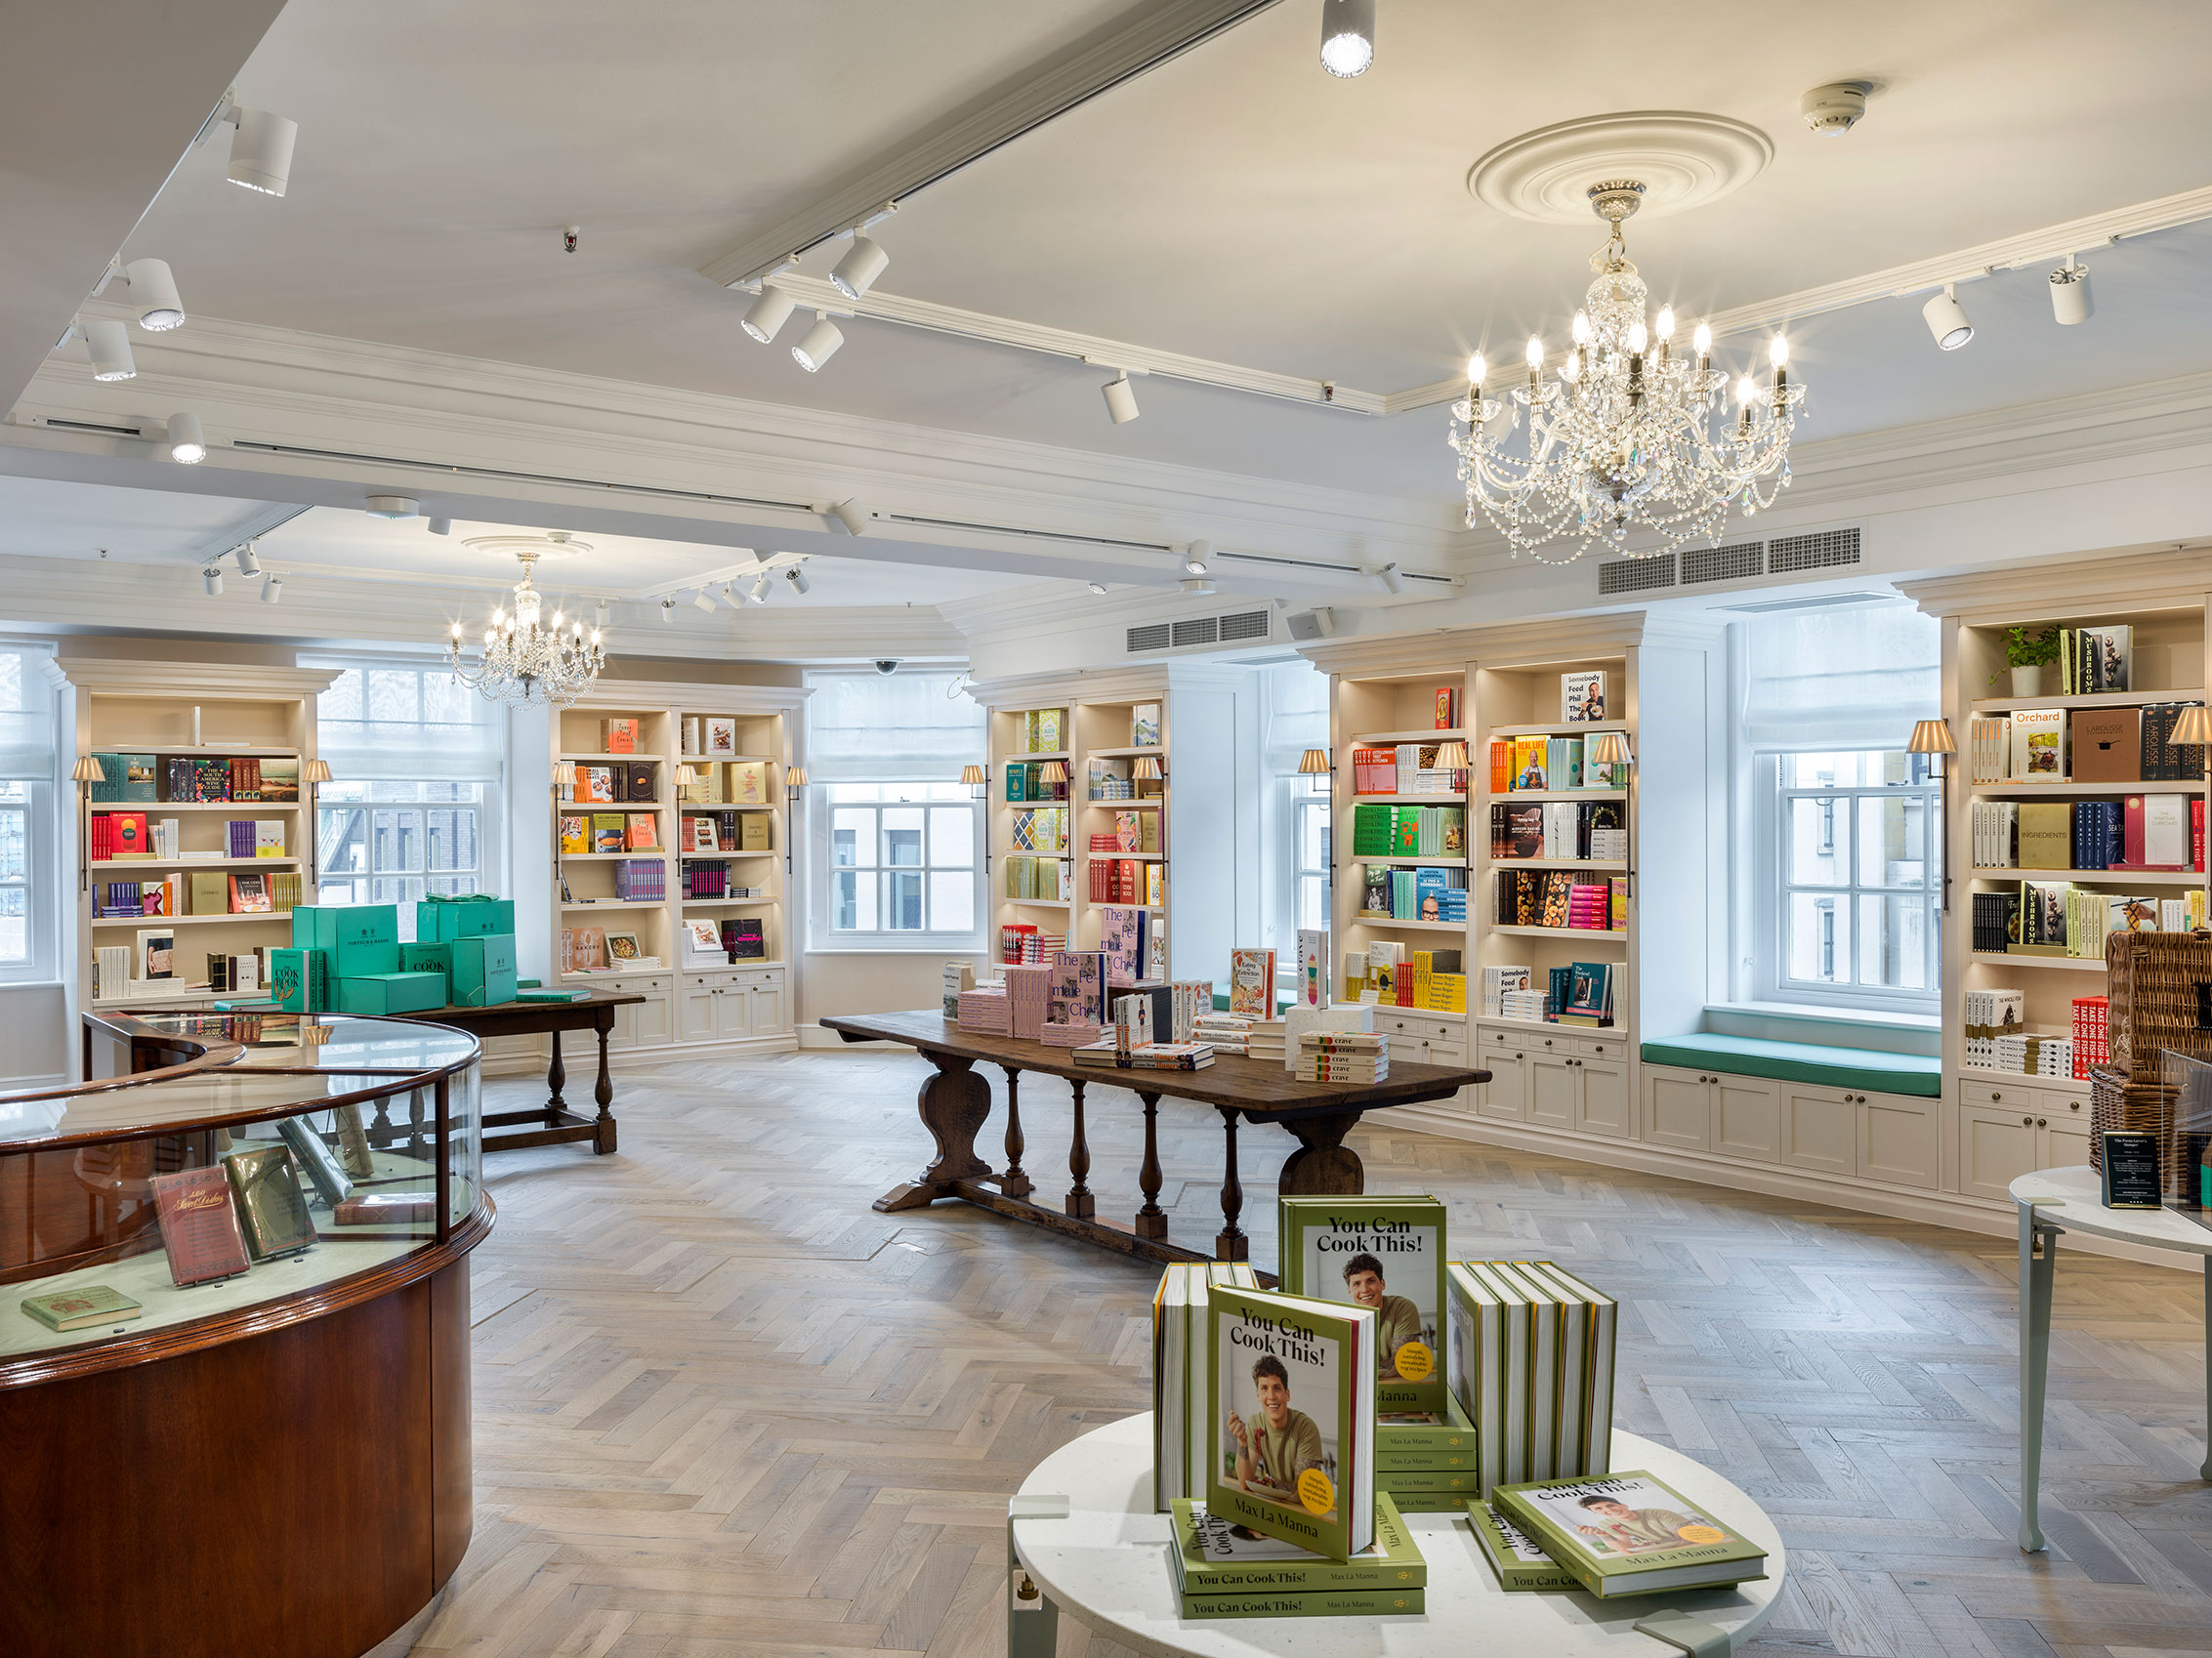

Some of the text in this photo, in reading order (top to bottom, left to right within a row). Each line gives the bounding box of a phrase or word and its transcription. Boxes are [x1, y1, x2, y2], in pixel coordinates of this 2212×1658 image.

[1568, 675, 1600, 683] Somebody
[2016, 712, 2059, 722] Orchard
[1518, 741, 1545, 749] REAL LIFE
[2150, 720, 2159, 766] LAROUSSE
[1104, 907, 1122, 921] The
[1122, 925, 1137, 938] Fe-
[1101, 937, 1123, 951] male
[1055, 953, 1078, 966] The
[1113, 957, 1136, 969] Chef
[414, 961, 444, 972] COOK
[275, 969, 298, 978] COOK
[1079, 970, 1100, 983] Fe-
[276, 977, 298, 987] BOOK
[1052, 984, 1081, 996] male
[1070, 1002, 1099, 1016] Chef
[1132, 1040, 1153, 1051] Hungry
[1329, 1217, 1411, 1233] You Can
[1317, 1235, 1422, 1252] Cook This!
[1241, 1307, 1314, 1342] You Can
[1231, 1326, 1325, 1367] Cook This!
[1539, 1477, 1622, 1491] You Can
[1538, 1482, 1645, 1500] Cook This!
[1235, 1498, 1318, 1538] Max La Manna
[1187, 1512, 1210, 1549] You Can
[1488, 1513, 1519, 1549] You Can
[1627, 1547, 1727, 1566] Max La Manna
[1197, 1572, 1306, 1585] You Can Cook This!
[1193, 1601, 1302, 1614] You Can Cook This!
